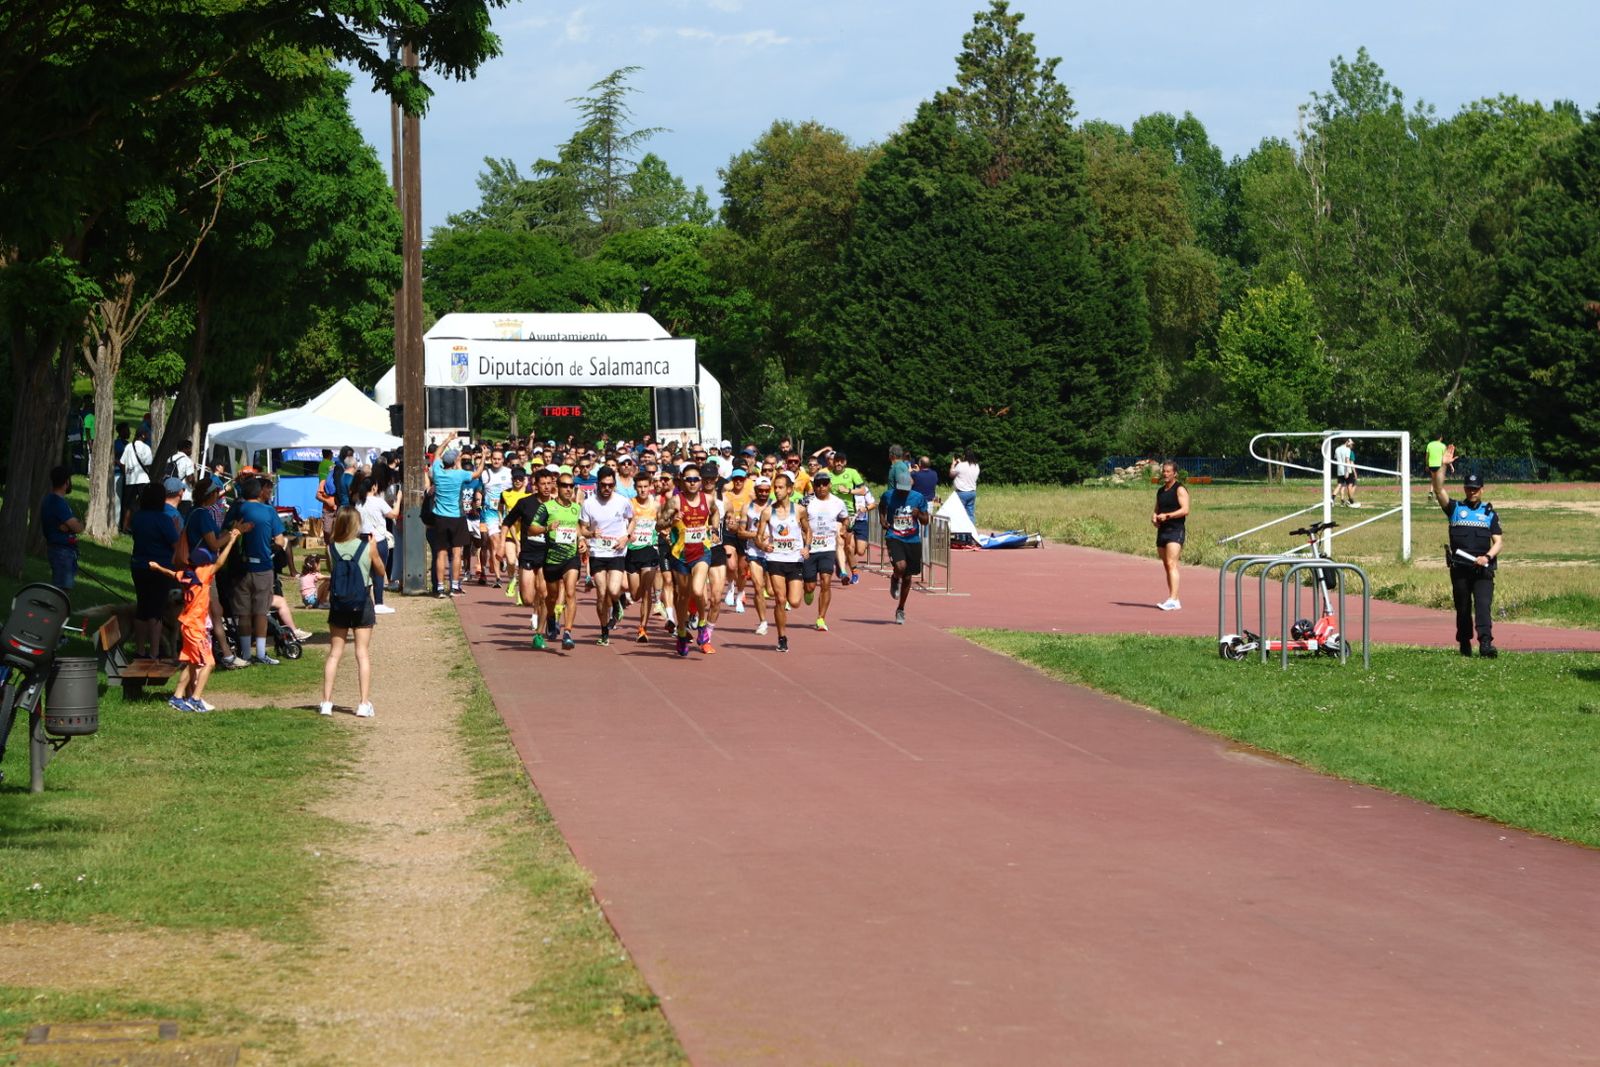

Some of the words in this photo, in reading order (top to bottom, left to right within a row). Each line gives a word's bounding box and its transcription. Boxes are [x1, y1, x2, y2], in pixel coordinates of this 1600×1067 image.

[528, 331, 608, 341] Ayuntamiento
[479, 355, 564, 379] Diputación
[569, 360, 583, 376] de
[589, 355, 670, 376] Salamanca
[562, 532, 572, 540] 74
[638, 535, 648, 543] 44
[691, 532, 702, 540] 40
[777, 541, 793, 549] 290
